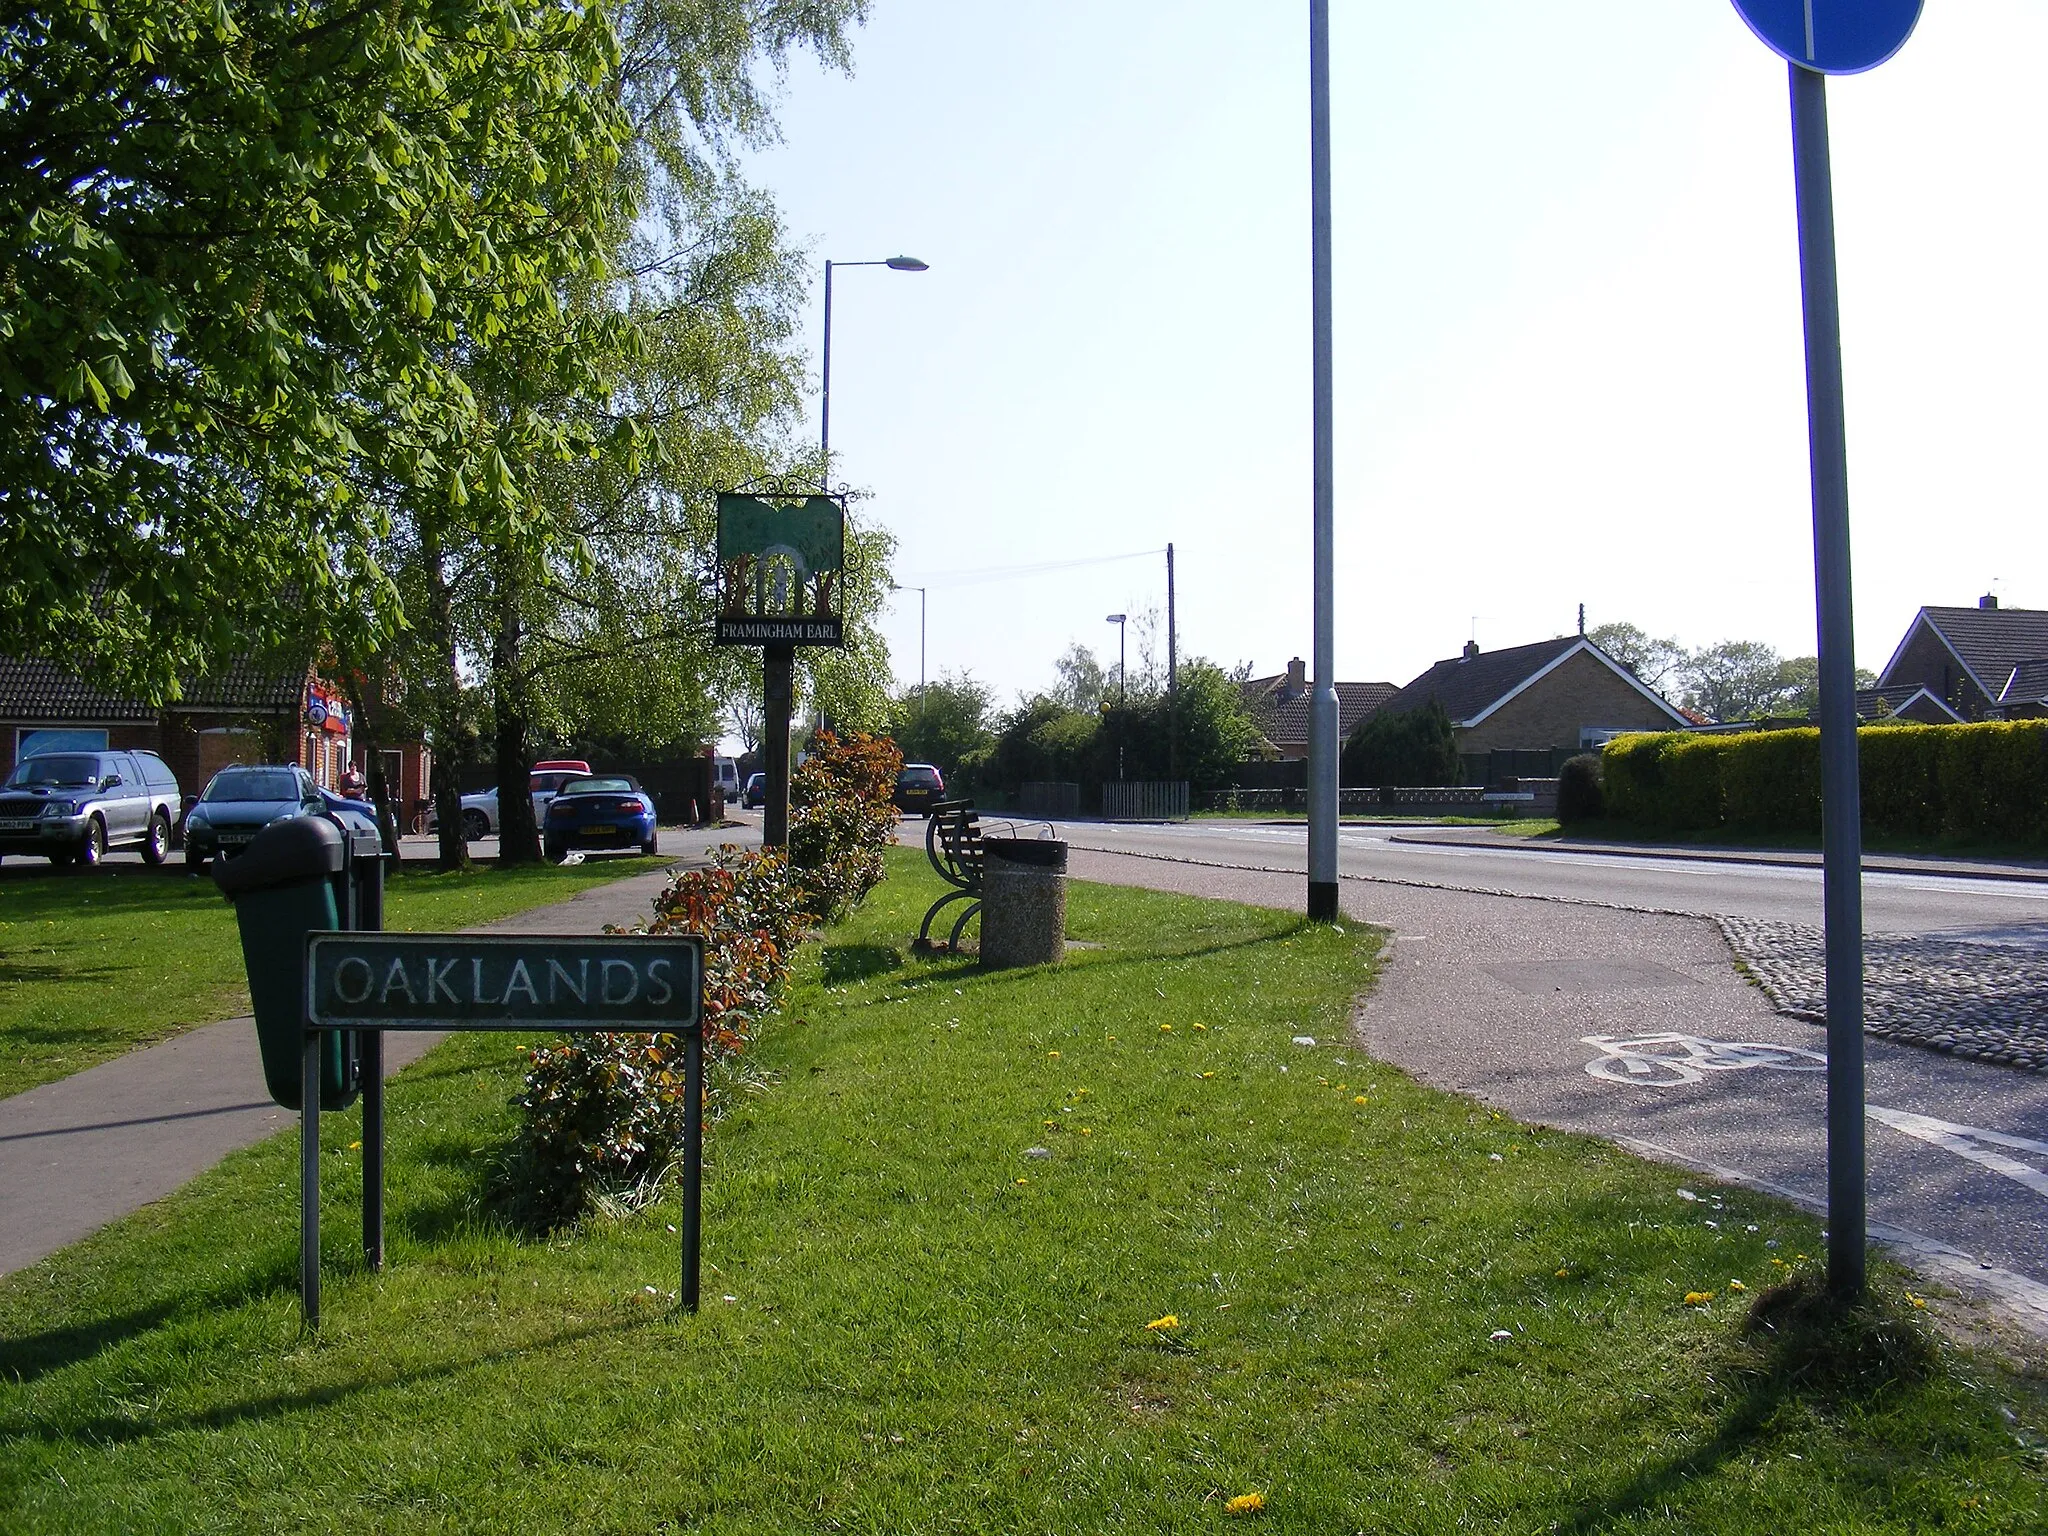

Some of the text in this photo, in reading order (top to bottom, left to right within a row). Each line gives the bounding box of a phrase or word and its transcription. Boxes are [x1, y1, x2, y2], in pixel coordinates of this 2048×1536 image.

[721, 623, 838, 639] FRAMINGHAM EARL
[333, 956, 673, 1005] OAKLANDS
